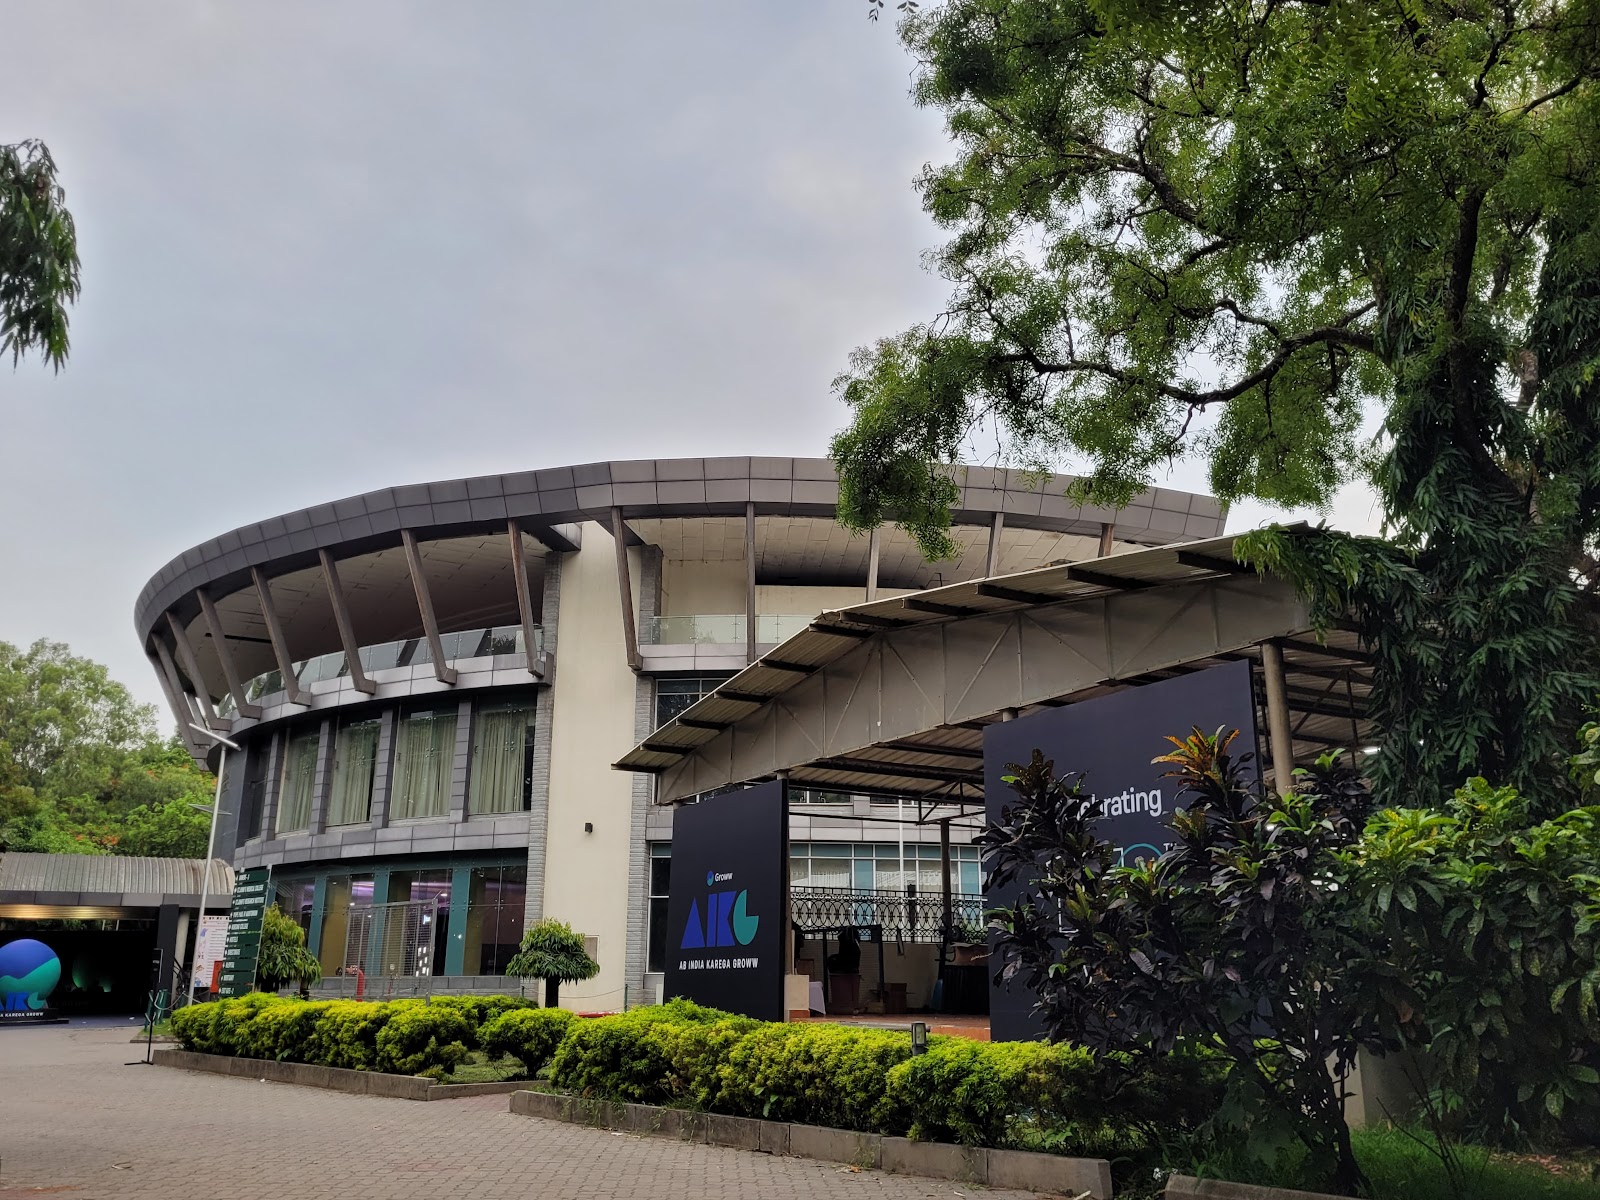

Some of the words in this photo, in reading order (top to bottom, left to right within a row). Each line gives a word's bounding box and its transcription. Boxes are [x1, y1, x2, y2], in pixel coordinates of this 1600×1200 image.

[1077, 787, 1162, 820] erating
[715, 872, 733, 881] Groww
[679, 961, 687, 970] AB
[688, 960, 705, 969] INDIA
[706, 959, 731, 969] KAREGA
[733, 958, 759, 968] GROWW
[0, 991, 45, 1010] IKG
